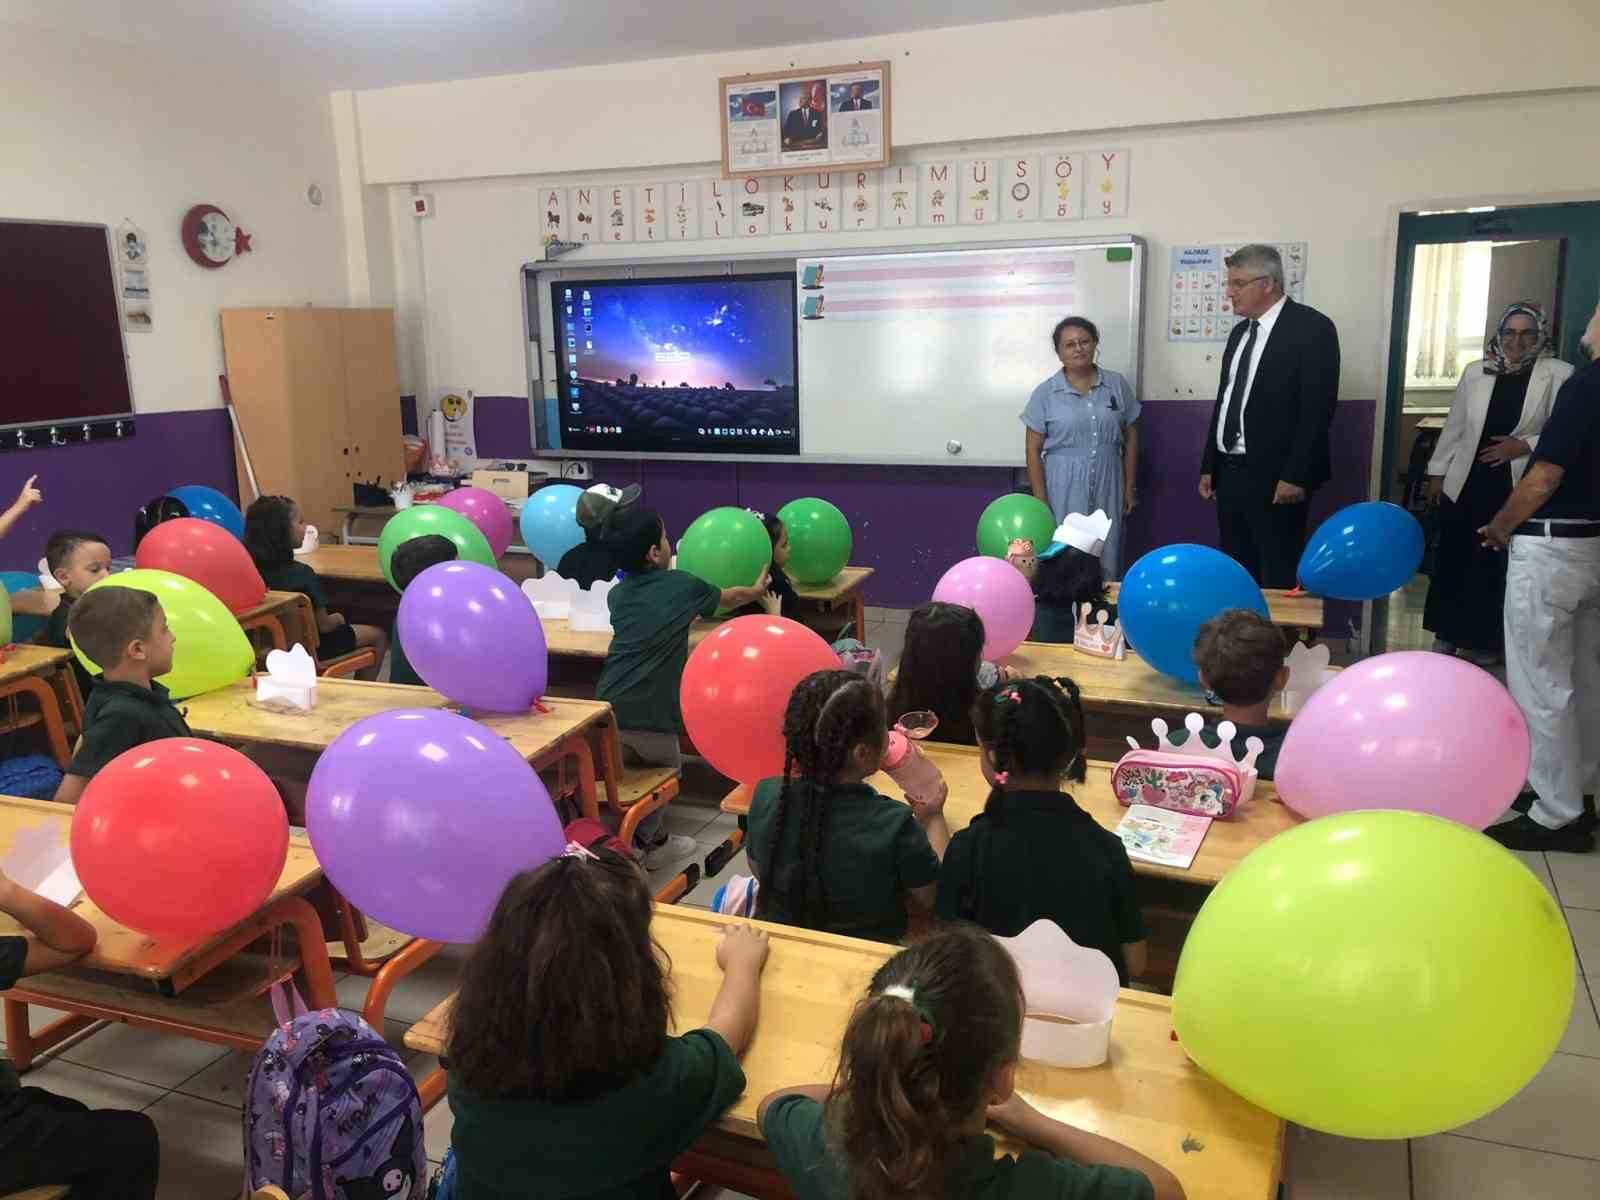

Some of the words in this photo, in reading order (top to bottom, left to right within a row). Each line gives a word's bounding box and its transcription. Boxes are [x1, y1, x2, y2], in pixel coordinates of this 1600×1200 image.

[548, 192, 559, 206] A
[579, 190, 590, 205] N
[613, 190, 621, 206] E
[645, 188, 654, 204] T
[712, 181, 721, 198] L
[744, 176, 759, 194] O
[783, 175, 794, 192] K
[818, 171, 830, 189] U
[856, 172, 866, 189] R
[930, 165, 948, 182] M
[974, 161, 986, 183] Ü
[1016, 160, 1027, 178] S
[1056, 156, 1071, 178] Ö
[1102, 153, 1115, 172] Y
[582, 233, 590, 241] n
[748, 224, 757, 234] o
[784, 216, 792, 232] k
[818, 220, 828, 230] u
[857, 218, 864, 226] r
[932, 213, 945, 223] m
[975, 208, 984, 221] ü
[1016, 208, 1024, 219] s
[1057, 203, 1067, 217] ö
[1102, 200, 1112, 215] y
